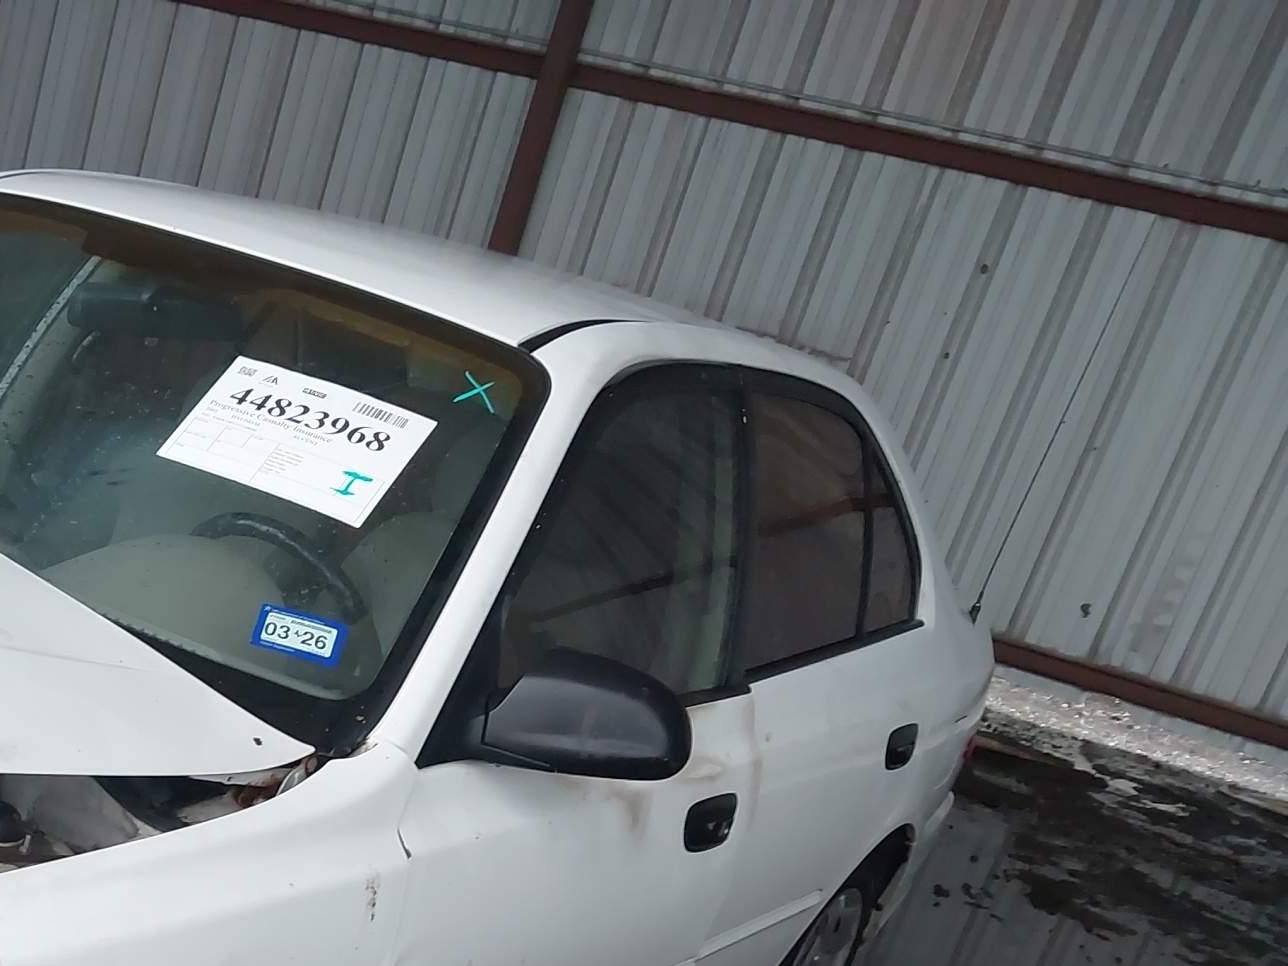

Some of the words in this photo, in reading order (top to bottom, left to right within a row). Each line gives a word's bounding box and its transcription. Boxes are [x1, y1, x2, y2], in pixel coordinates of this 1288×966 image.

[209, 399, 257, 418] Progressive
[256, 413, 291, 431] Casualty
[292, 425, 333, 444] Insurance
[230, 387, 392, 452] 44823968
[264, 621, 291, 640] 03
[300, 630, 329, 650] 26
